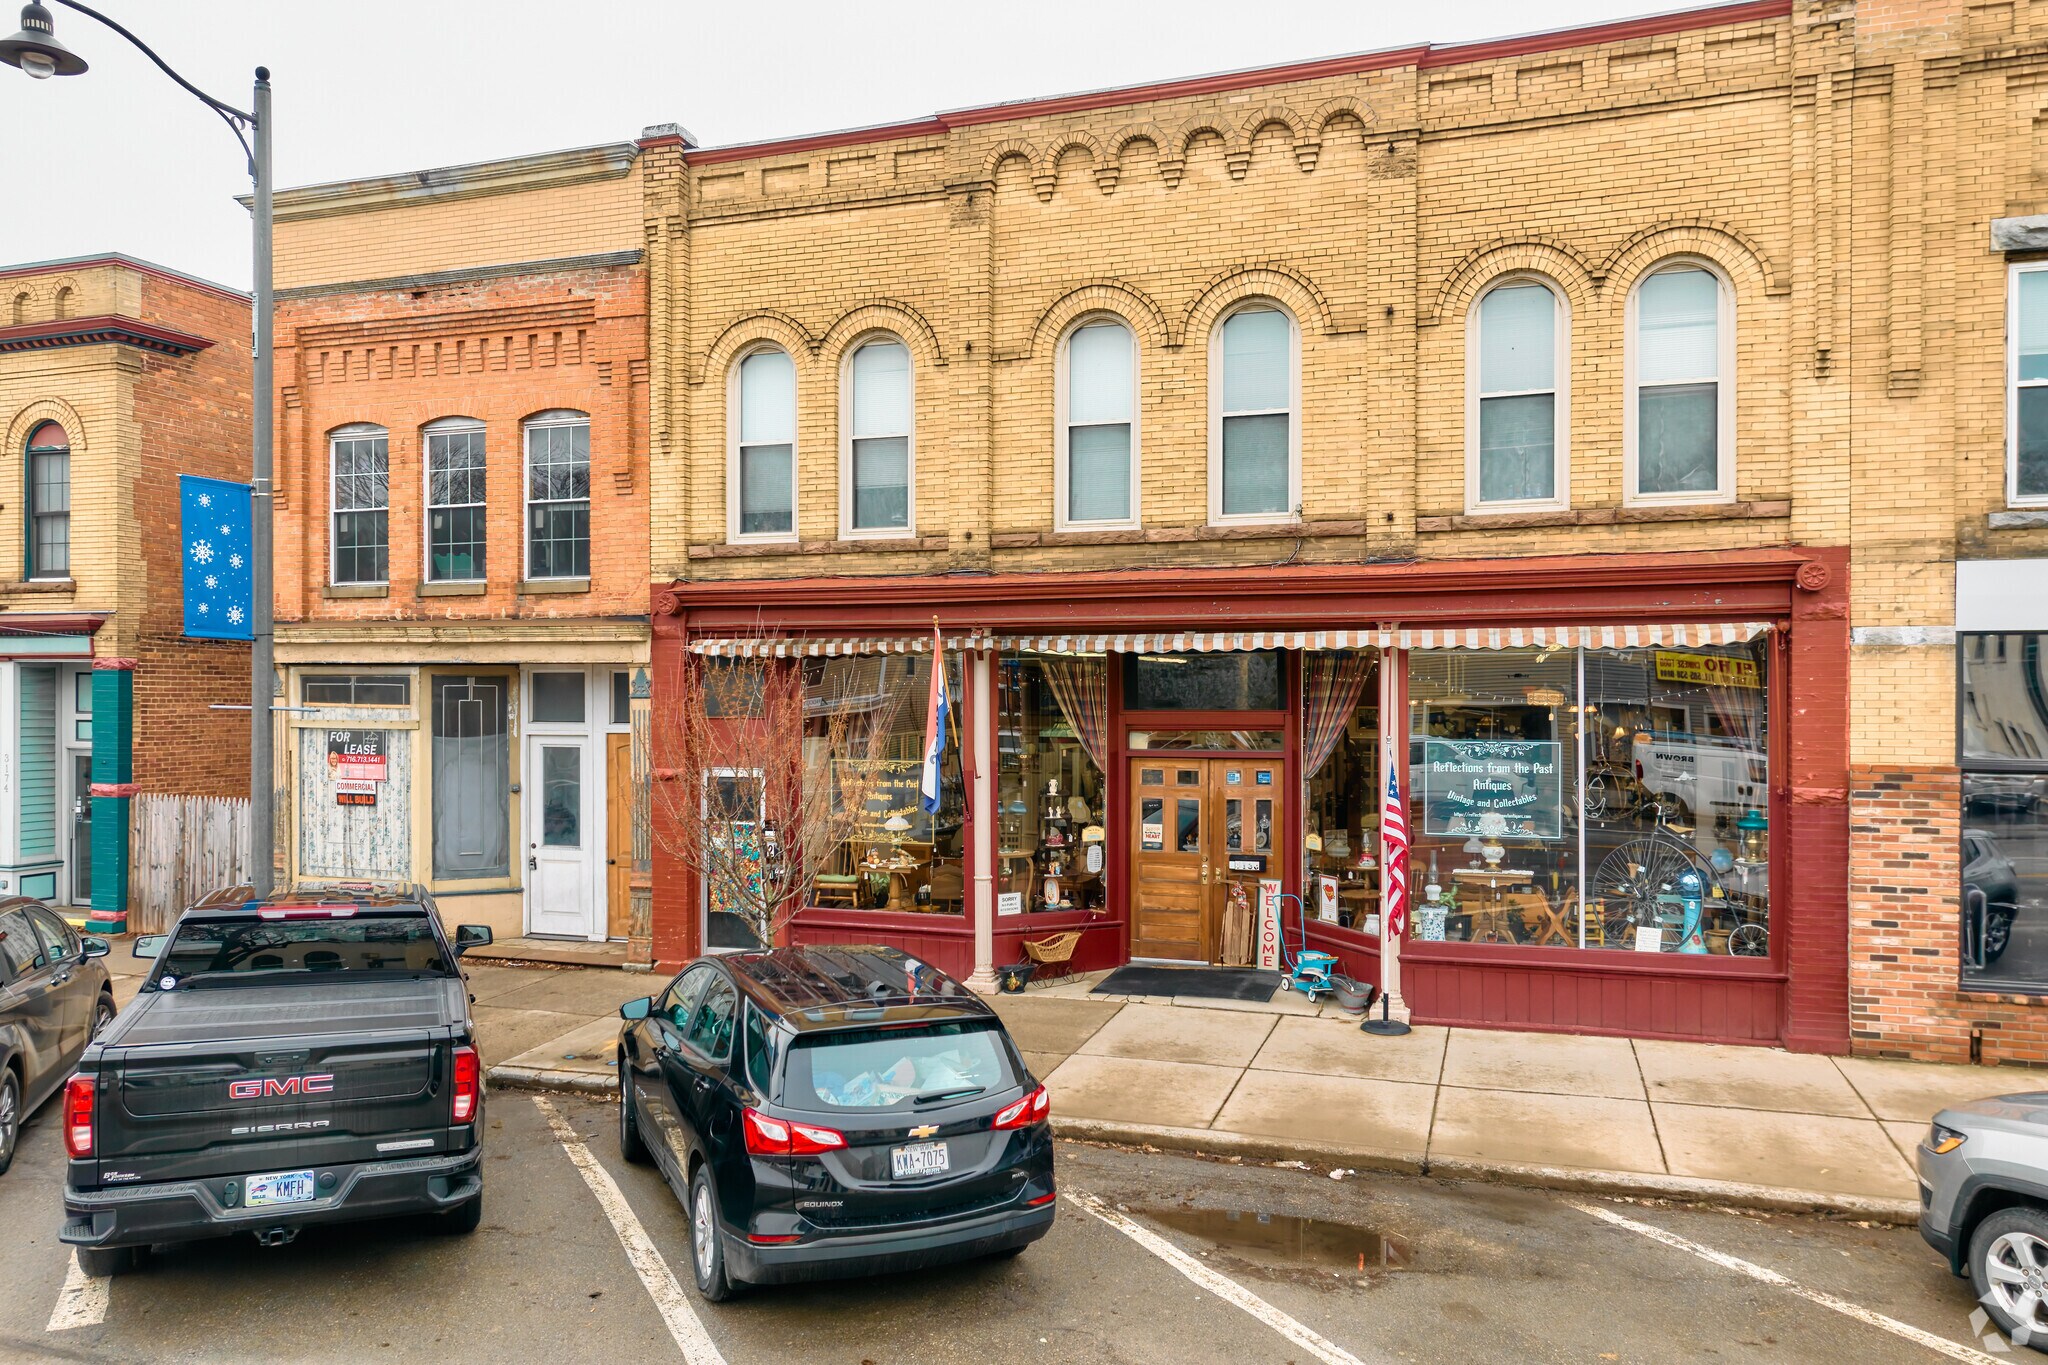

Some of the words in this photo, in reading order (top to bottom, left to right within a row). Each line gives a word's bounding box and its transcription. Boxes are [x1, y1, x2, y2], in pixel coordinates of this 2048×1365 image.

[330, 731, 351, 742] FOR
[344, 744, 377, 755] LEASE
[1433, 760, 1484, 773] Reflections
[1487, 762, 1510, 773] from
[1514, 762, 1530, 774] the
[1533, 762, 1554, 774] Past
[336, 782, 374, 791] COMMERCIAL
[876, 779, 892, 788] from
[894, 780, 904, 788] the
[906, 780, 919, 789] Past
[1473, 778, 1512, 793] Antiques
[338, 794, 353, 804] WILL
[354, 795, 374, 804] BUILD
[1446, 790, 1474, 806] Vintage
[1476, 800, 1490, 808] and
[1494, 794, 1538, 809] Collectables
[1262, 884, 1277, 967] WELCOME
[229, 1074, 334, 1099] GMC
[231, 1120, 330, 1135] SIERRA
[276, 1180, 304, 1197] KMFH
